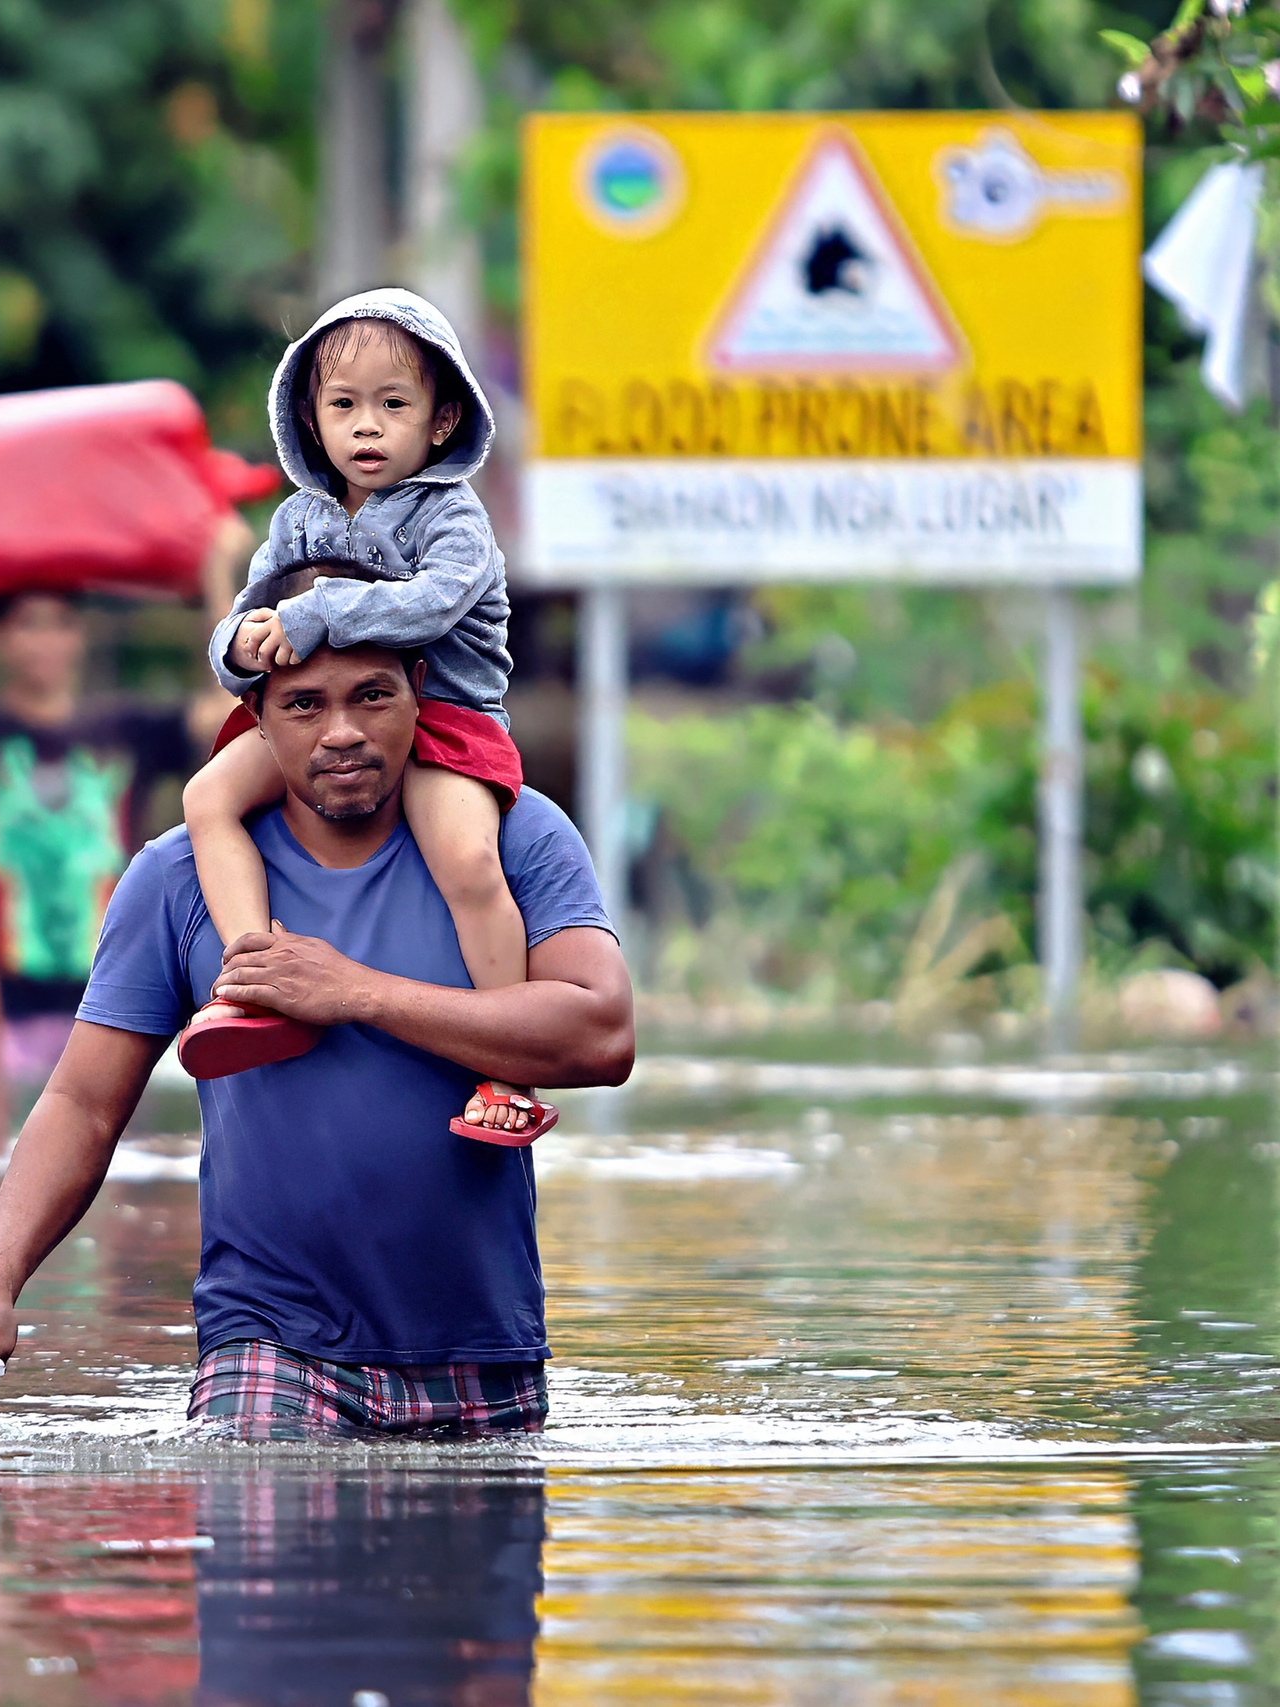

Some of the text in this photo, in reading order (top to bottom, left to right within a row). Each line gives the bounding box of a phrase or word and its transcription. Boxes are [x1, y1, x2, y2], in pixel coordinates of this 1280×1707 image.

[556, 375, 1109, 455] FLOOD PRONE AREA
